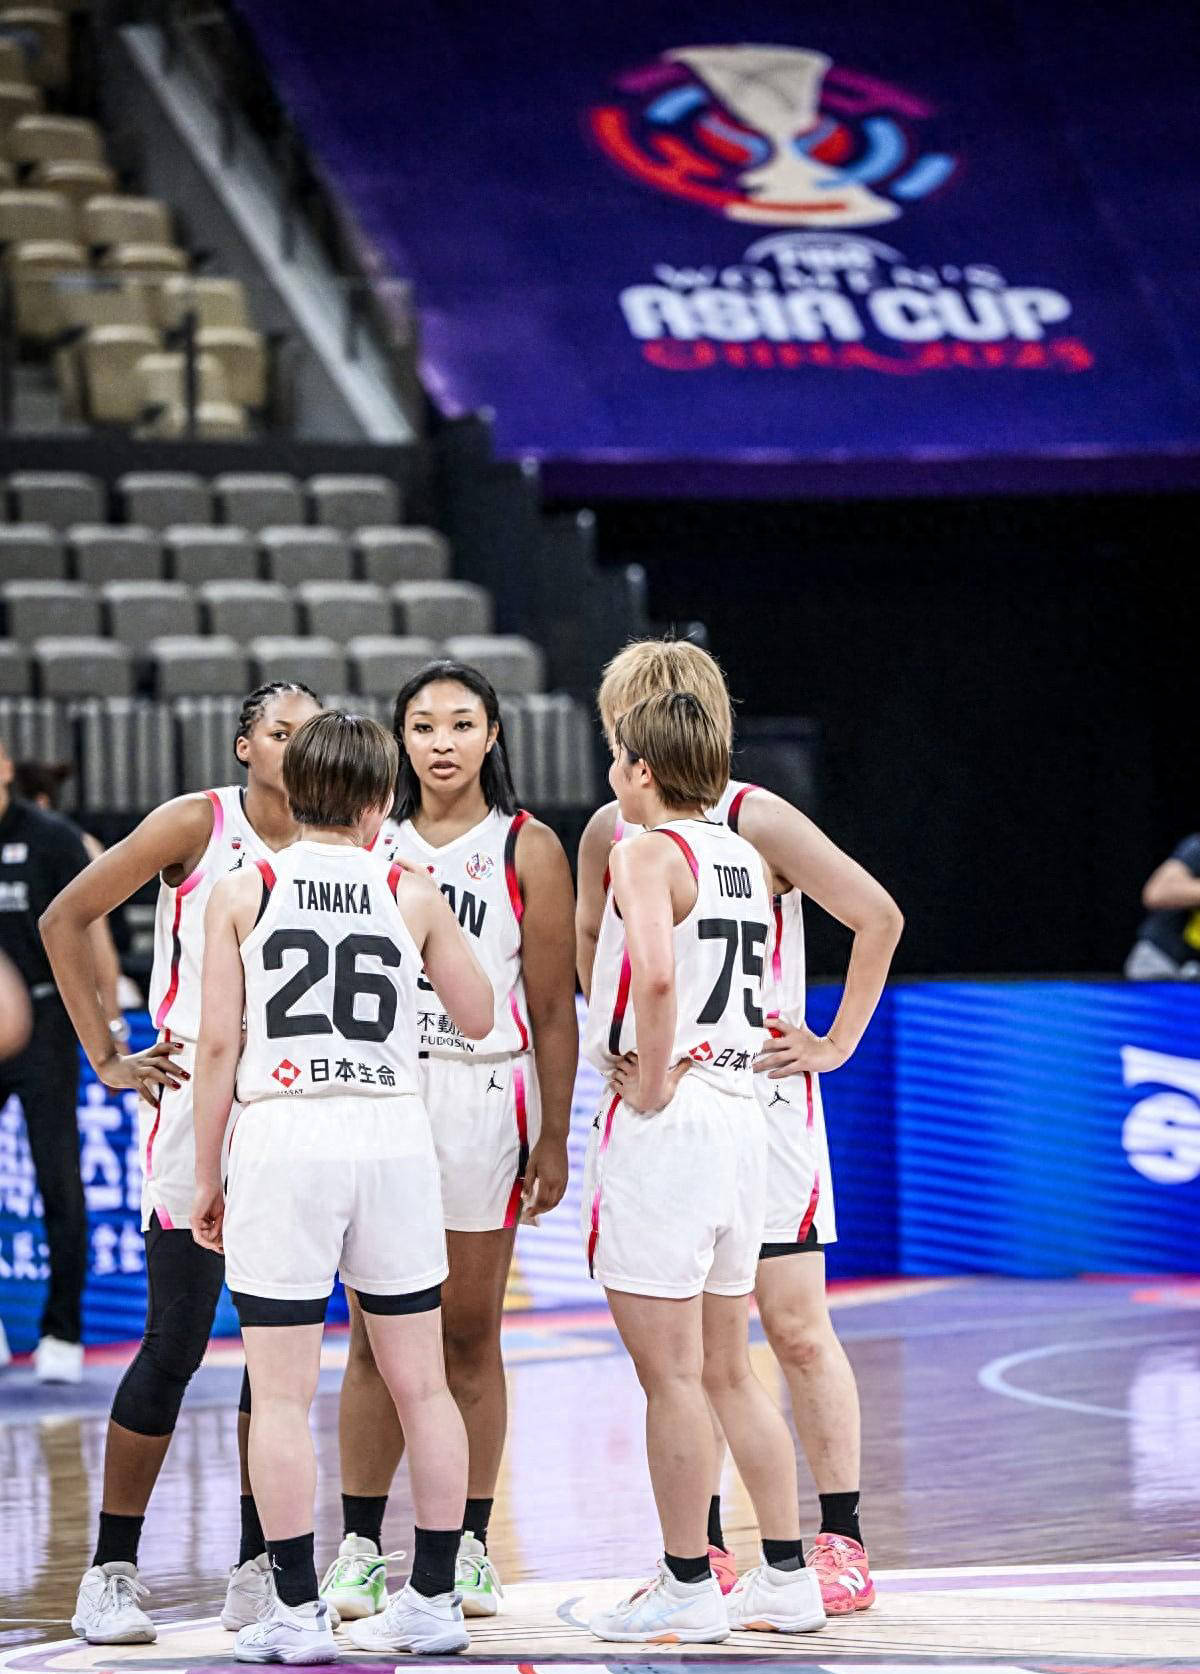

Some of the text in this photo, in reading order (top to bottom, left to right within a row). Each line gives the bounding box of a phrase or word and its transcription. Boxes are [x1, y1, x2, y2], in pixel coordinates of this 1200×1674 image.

[620, 284, 1074, 342] ASIA CUP
[293, 879, 372, 915] TANAKA
[713, 864, 752, 899] TODO
[262, 928, 402, 1043] 26
[696, 918, 768, 1028] 75
[417, 1011, 464, 1037] 不動
[310, 1057, 396, 1087] 日本生命
[713, 1048, 758, 1072] 日本
